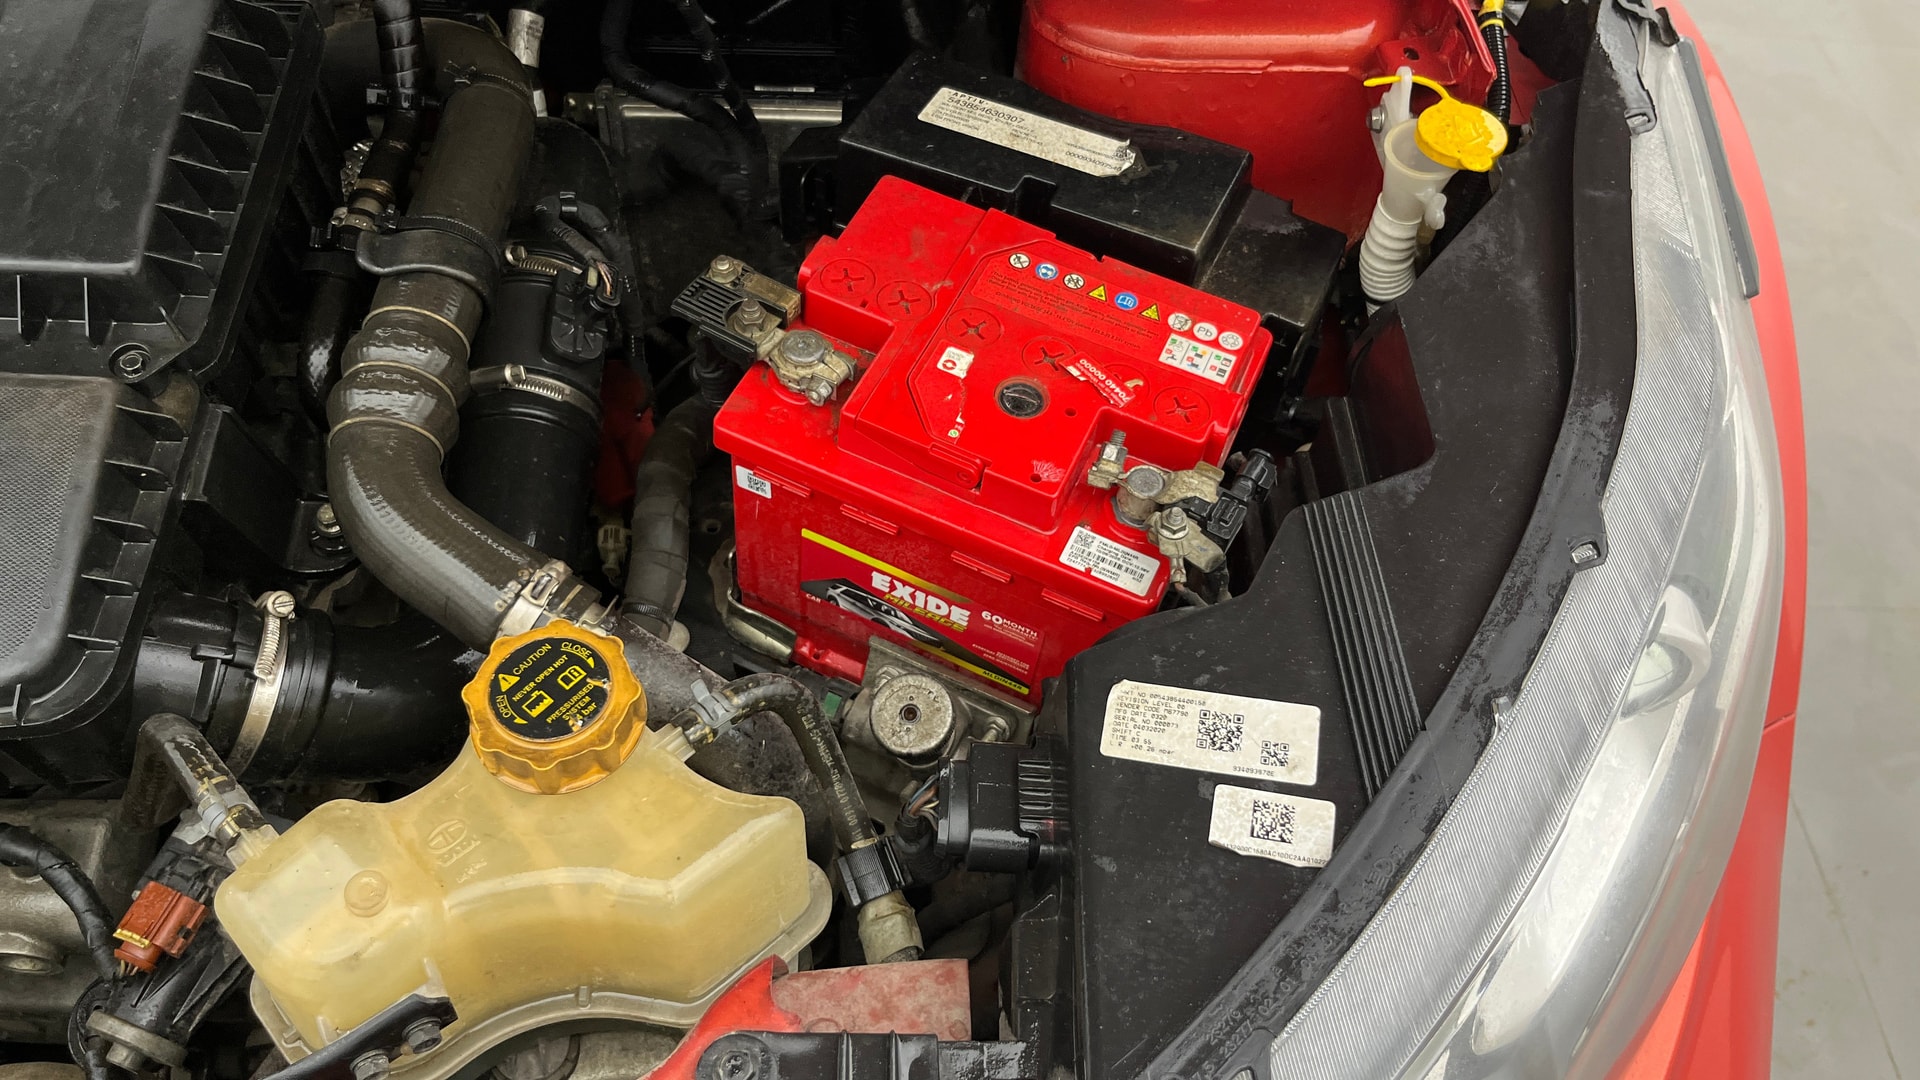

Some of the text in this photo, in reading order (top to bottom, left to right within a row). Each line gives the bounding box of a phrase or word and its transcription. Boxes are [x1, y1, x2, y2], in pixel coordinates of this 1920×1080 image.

[952, 92, 985, 105] APTIV
[1197, 326, 1213, 337] Pb
[1078, 357, 1106, 381] 00000
[1102, 377, 1131, 403] 70440
[806, 593, 822, 604] CAR
[871, 571, 971, 626] EXIDE
[883, 594, 968, 633] MILEAGE
[981, 611, 1002, 625] 60
[1003, 619, 1038, 637] MONTH
[513, 641, 592, 676] CAUTION CLOSE
[512, 654, 569, 702] NEVER OPEN HOT
[496, 696, 511, 718] OPEN
[546, 683, 594, 723] PRESSURISED
[581, 702, 597, 715] bar
[1110, 733, 1127, 741] TIME
[1111, 727, 1131, 735] SHIFT
